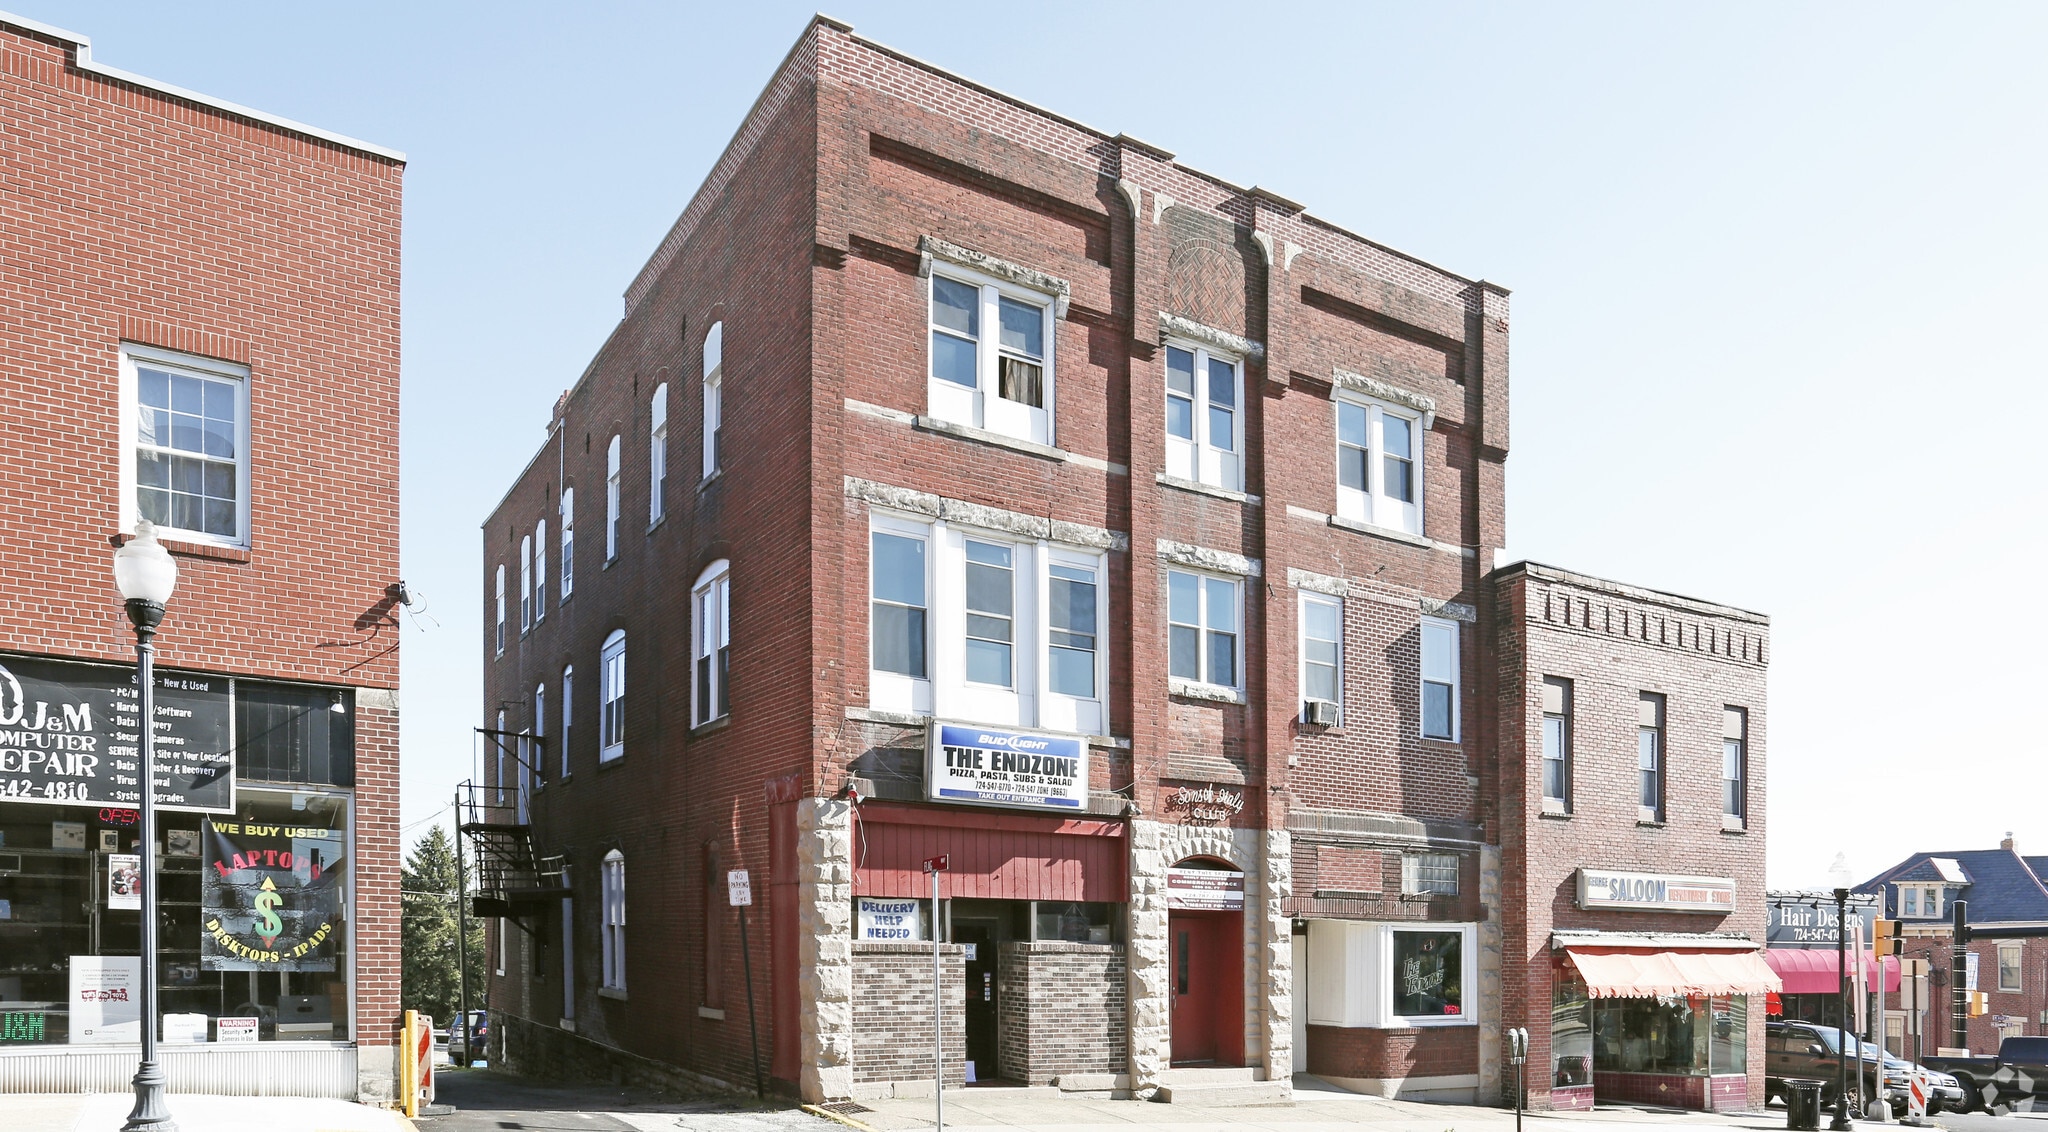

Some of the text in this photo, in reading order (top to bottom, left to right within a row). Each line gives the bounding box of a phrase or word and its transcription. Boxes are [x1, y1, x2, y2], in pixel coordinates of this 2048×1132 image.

[164, 678, 179, 688] New
[181, 680, 188, 690] &
[189, 682, 209, 691] Used
[20, 701, 93, 733] J&M
[116, 716, 135, 727] Data
[152, 734, 185, 745] Cameras
[978, 734, 1049, 750] BUD LIGHT
[157, 749, 171, 759] Site
[173, 751, 181, 760] or
[182, 752, 198, 761] Your
[200, 752, 230, 763] Location
[943, 747, 1078, 778] THE ENDZONE
[116, 760, 136, 771] Data
[173, 765, 180, 774] &
[181, 765, 216, 777] Recovery
[116, 775, 137, 785] Virus
[949, 768, 1073, 787] PIZZA, PASTA, SUBS & SALAD
[1014, 785, 1036, 794] 724-547
[977, 792, 996, 800] TAKE
[1011, 796, 1046, 804] ENTRANCE
[1194, 807, 1226, 820] CLUB
[212, 822, 329, 838] WE BUY USED
[213, 849, 323, 880] LAPTOPS
[734, 873, 744, 881] NO
[1589, 876, 1731, 903] GEORGE SALOOM DEPARTMENT STORE
[861, 901, 915, 913] DELIVERY
[875, 915, 904, 926] HELP
[1780, 906, 1811, 927] Hair
[1816, 908, 1865, 931] Desgns
[867, 928, 910, 939] NEEDED
[205, 918, 281, 963] DESKTOPS
[292, 921, 332, 958] IPADS
[0, 1012, 44, 1040] J&M
[221, 1019, 255, 1027] WARNING
